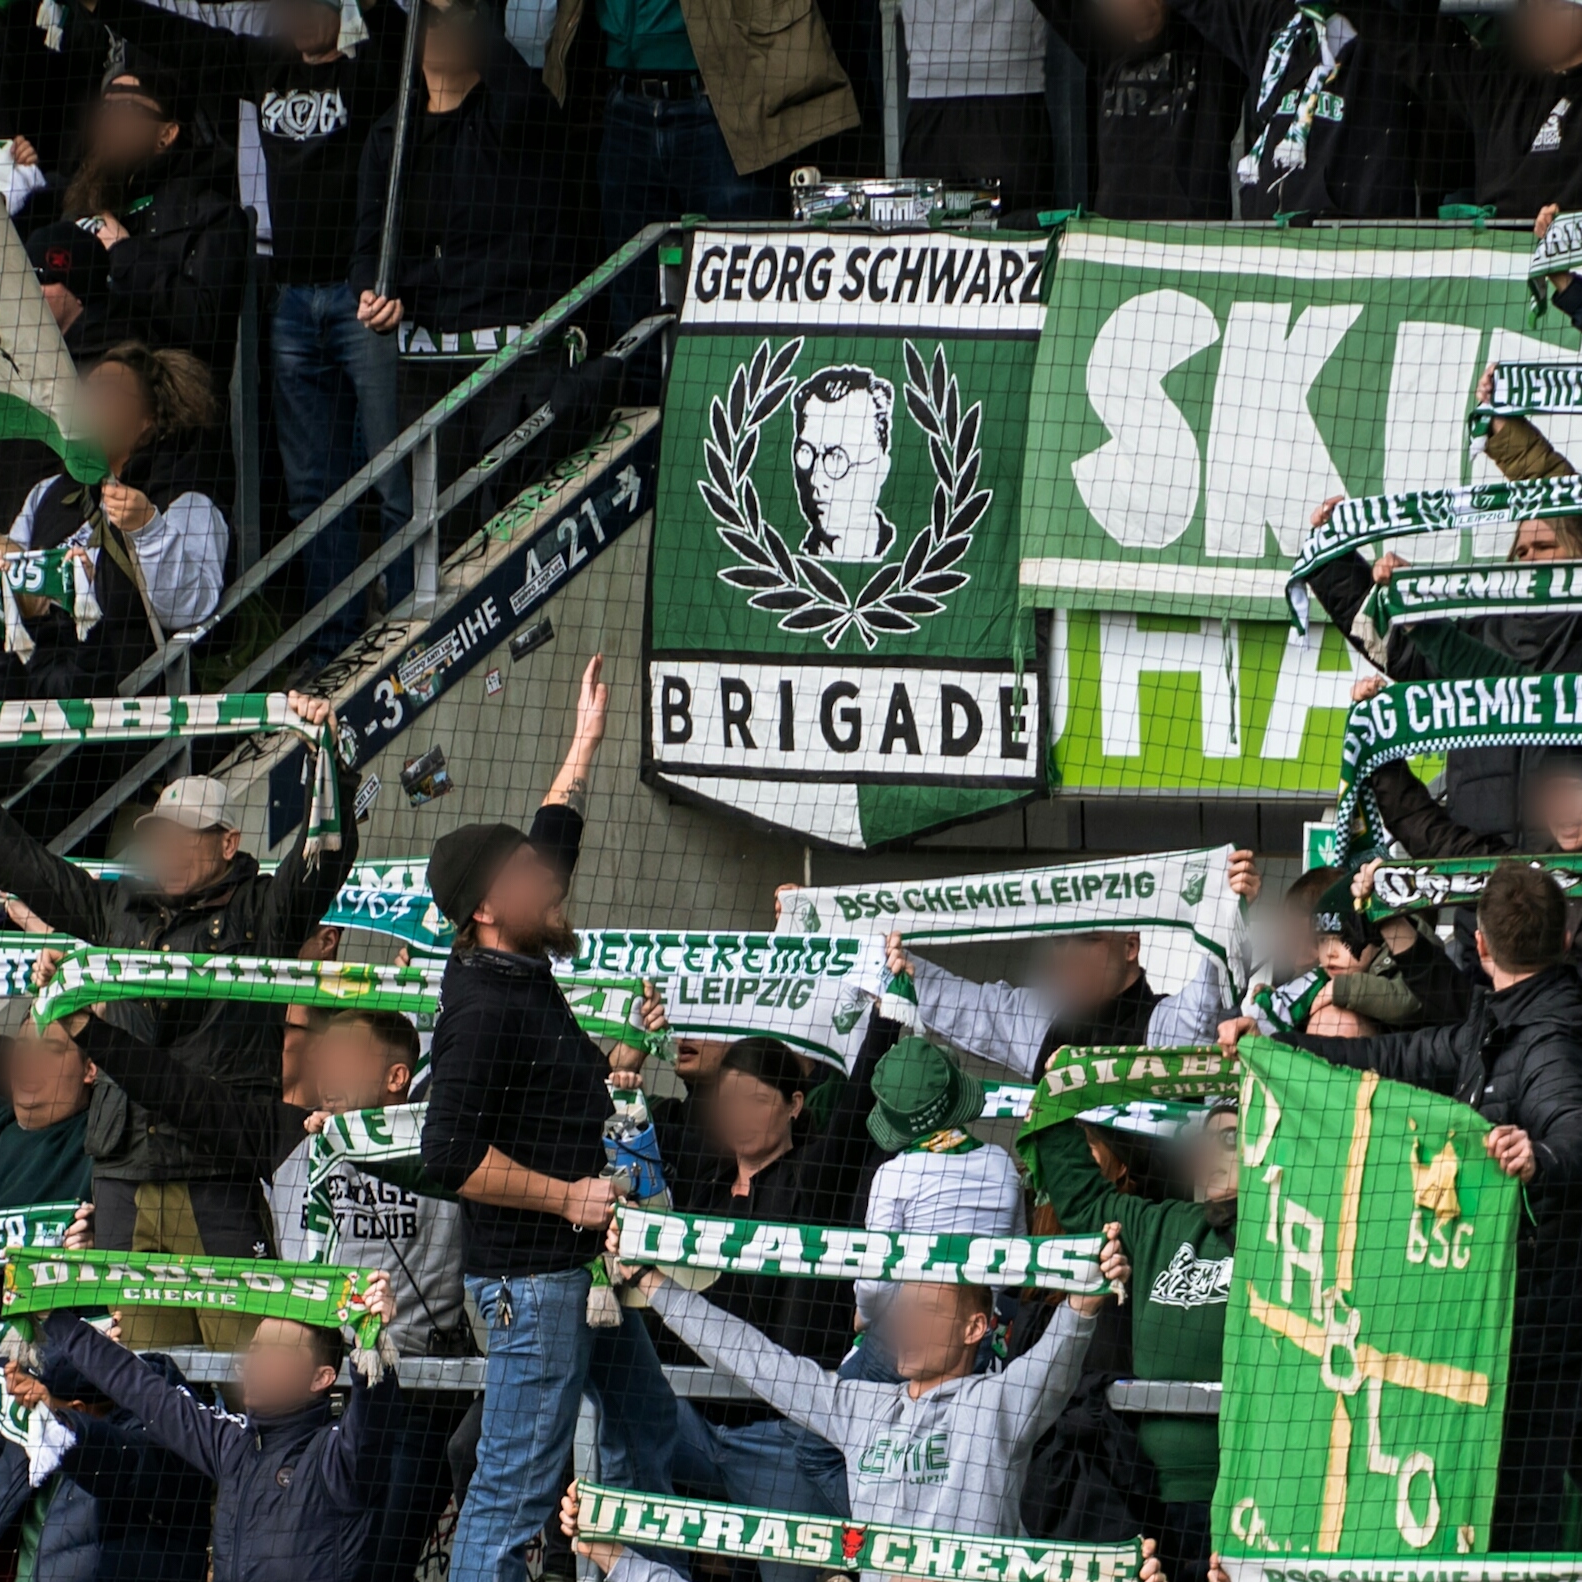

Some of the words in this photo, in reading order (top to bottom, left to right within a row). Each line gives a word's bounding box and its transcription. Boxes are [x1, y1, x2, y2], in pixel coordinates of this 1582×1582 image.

[694, 245, 831, 304] GEORG
[837, 246, 1047, 304] SCHWARZ
[1396, 570, 1537, 604] CHEMIE
[439, 596, 502, 674] EIHE
[661, 674, 1030, 761] BRIGADE
[1407, 676, 1543, 736] CHEMIE
[835, 889, 900, 922] BSG
[904, 880, 1027, 914] CHEMIE
[1032, 870, 1157, 905] LEIPZIG
[691, 975, 817, 1010] LEIPZIG
[1046, 1052, 1239, 1099] DIAB
[1150, 1081, 1239, 1098] CHEM
[353, 1211, 418, 1240] CLUB
[620, 1206, 1109, 1293] DIABLOS
[28, 1258, 331, 1302] DIABLOS
[122, 1287, 237, 1307] CHEMIE
[576, 1481, 833, 1563] ULTRAS
